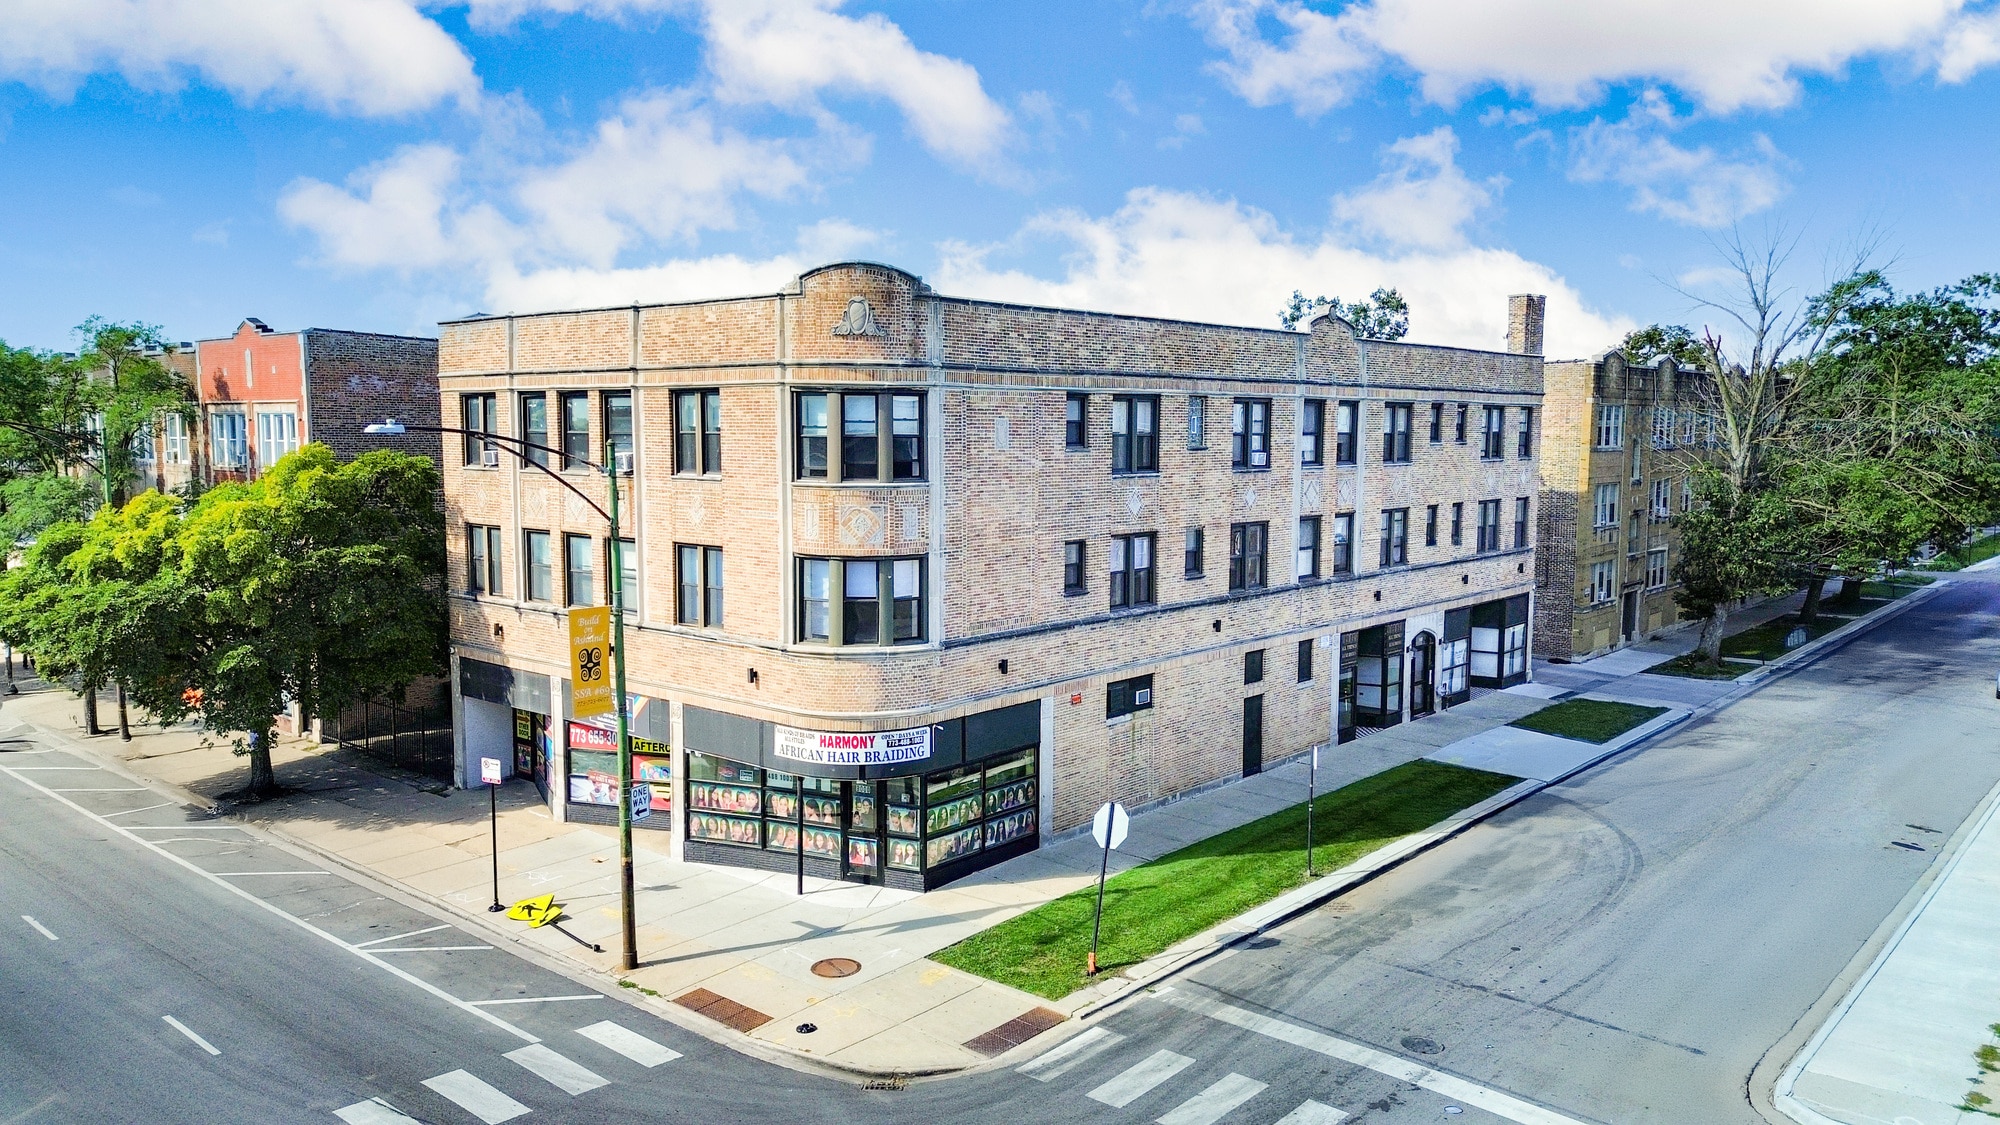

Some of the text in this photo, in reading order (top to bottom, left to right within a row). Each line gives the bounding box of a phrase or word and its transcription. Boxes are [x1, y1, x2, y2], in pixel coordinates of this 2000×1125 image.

[577, 614, 601, 627] Build
[574, 687, 592, 699] SSA
[570, 728, 617, 746] 773 655-30
[819, 734, 876, 749] HARMONY
[898, 731, 912, 739] DAYS
[633, 740, 671, 753] AFTERC
[779, 743, 925, 763] AFRICAN HAIR BRAIDING
[632, 786, 648, 798] ONE
[633, 796, 648, 808] WAY
